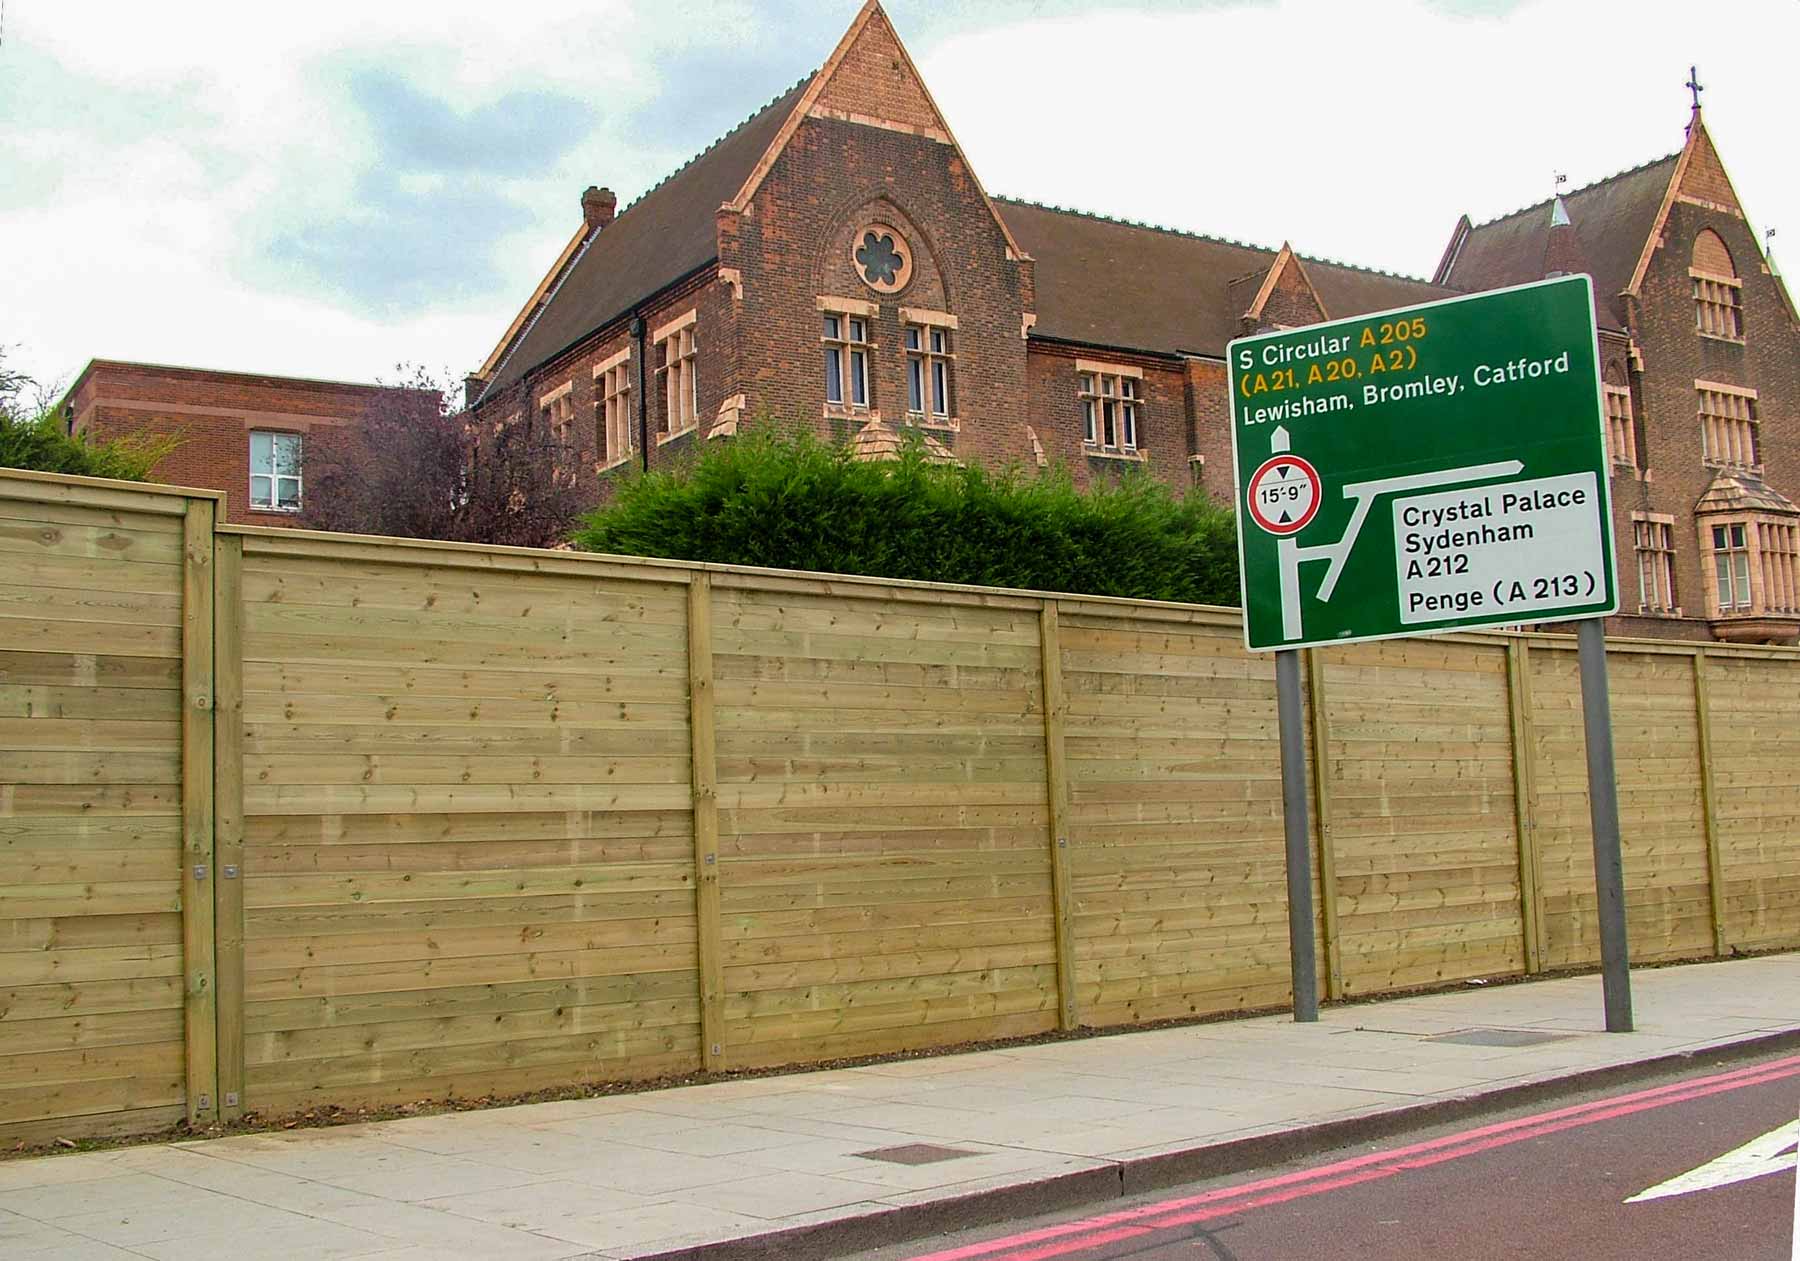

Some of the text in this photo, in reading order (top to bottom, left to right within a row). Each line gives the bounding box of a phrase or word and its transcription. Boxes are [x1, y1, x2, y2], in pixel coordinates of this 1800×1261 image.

[1239, 317, 1426, 370] S Circular A205
[1240, 345, 1417, 398] (A21, A20, A2)
[1243, 351, 1569, 426] Lewisham, Bromley, Catford
[1402, 489, 1586, 528] Crystal Palace
[1405, 524, 1534, 555] Sydenham
[1406, 553, 1469, 580] A212
[1409, 590, 1484, 613] Penge
